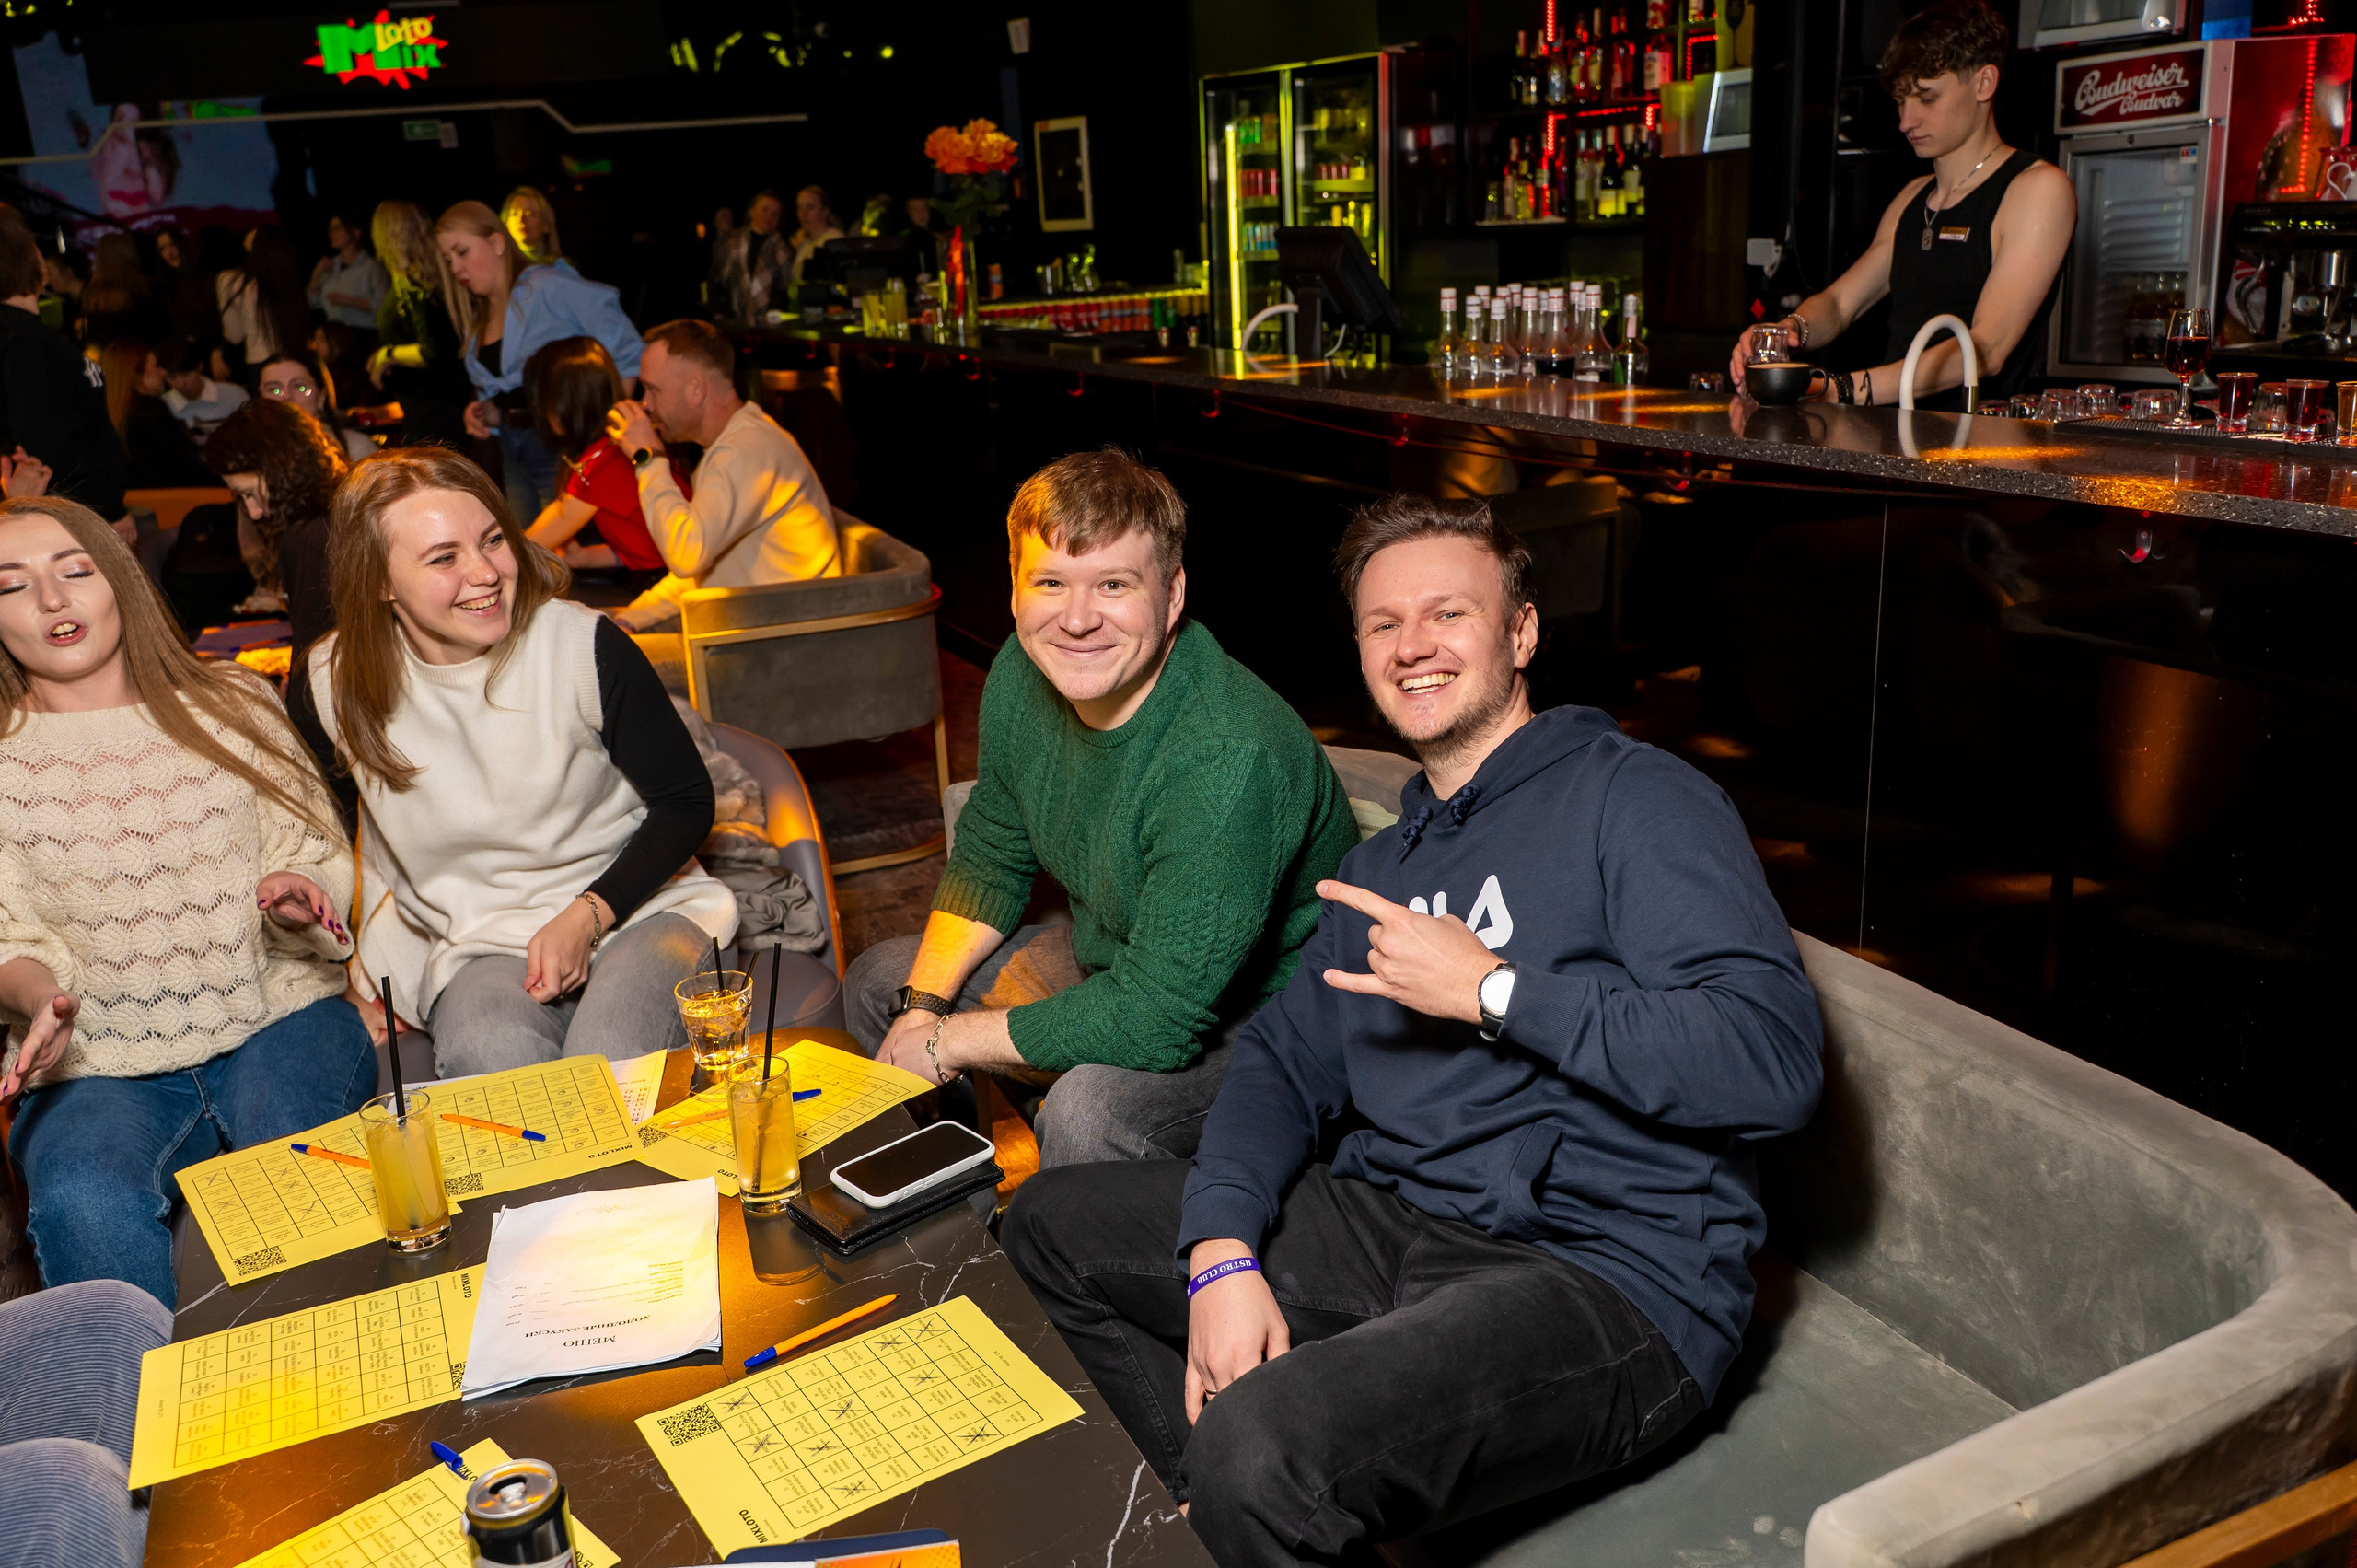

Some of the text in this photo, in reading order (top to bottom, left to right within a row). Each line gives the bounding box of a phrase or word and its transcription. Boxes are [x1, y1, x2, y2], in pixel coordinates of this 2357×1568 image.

[2074, 62, 2189, 111] Budweiser
[2119, 90, 2185, 115] Budvar
[587, 1144, 633, 1158] MIXLOTO
[716, 1167, 737, 1179] LOTO
[461, 1273, 472, 1298] MIXLOTO
[1197, 1270, 1218, 1284] CLUB
[525, 1314, 651, 1338] ХОЛОДНЫЕ ЗАКУСКИ
[563, 1335, 617, 1348] МЕНЮ
[737, 1507, 769, 1544] MIXLOTO
